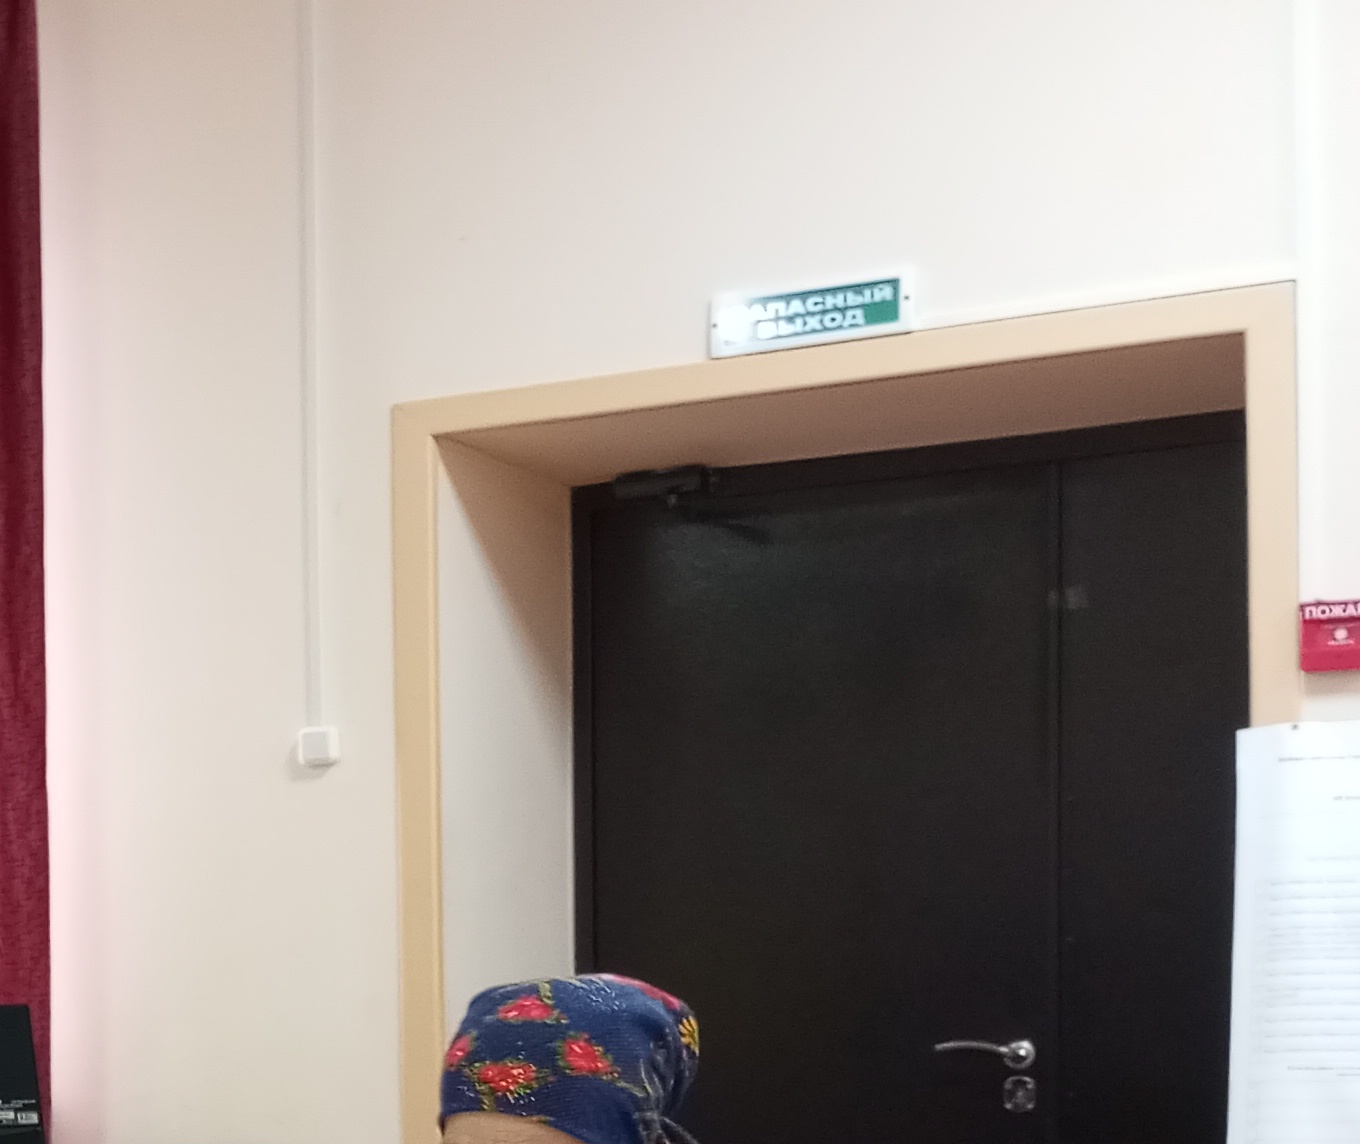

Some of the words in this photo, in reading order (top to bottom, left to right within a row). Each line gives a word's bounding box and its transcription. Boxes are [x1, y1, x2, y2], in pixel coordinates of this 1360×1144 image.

[737, 284, 893, 322] АПАСНЫЙ
[756, 309, 864, 339] ВЫХОД
[1305, 604, 1360, 619] ПОЖА
